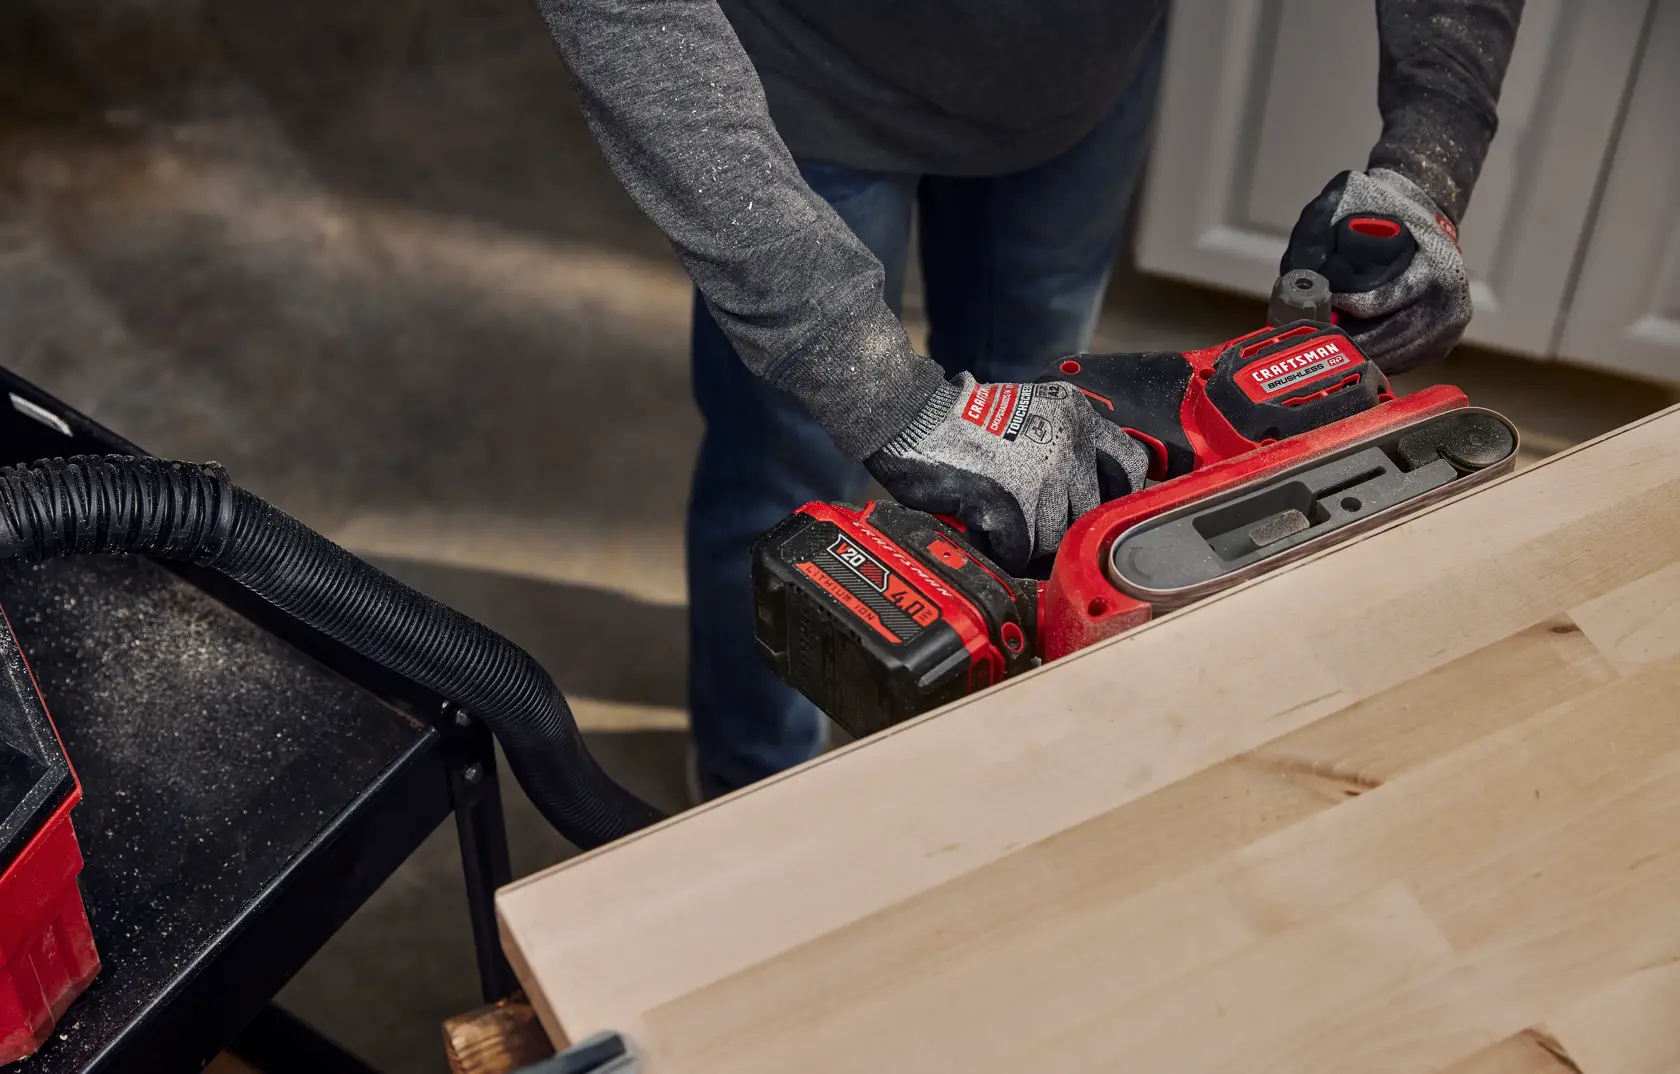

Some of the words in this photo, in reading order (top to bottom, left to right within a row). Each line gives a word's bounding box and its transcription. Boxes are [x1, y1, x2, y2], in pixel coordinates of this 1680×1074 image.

[1252, 343, 1340, 382] CRAFTSMAN
[1267, 363, 1325, 390] BRUSHLESS
[1048, 385, 1060, 398] A2
[836, 542, 866, 568] V20
[852, 520, 953, 598] CRAFTSMAN
[805, 564, 852, 600] LITHIUM
[854, 602, 876, 622] ION
[891, 591, 925, 617] 4.0
